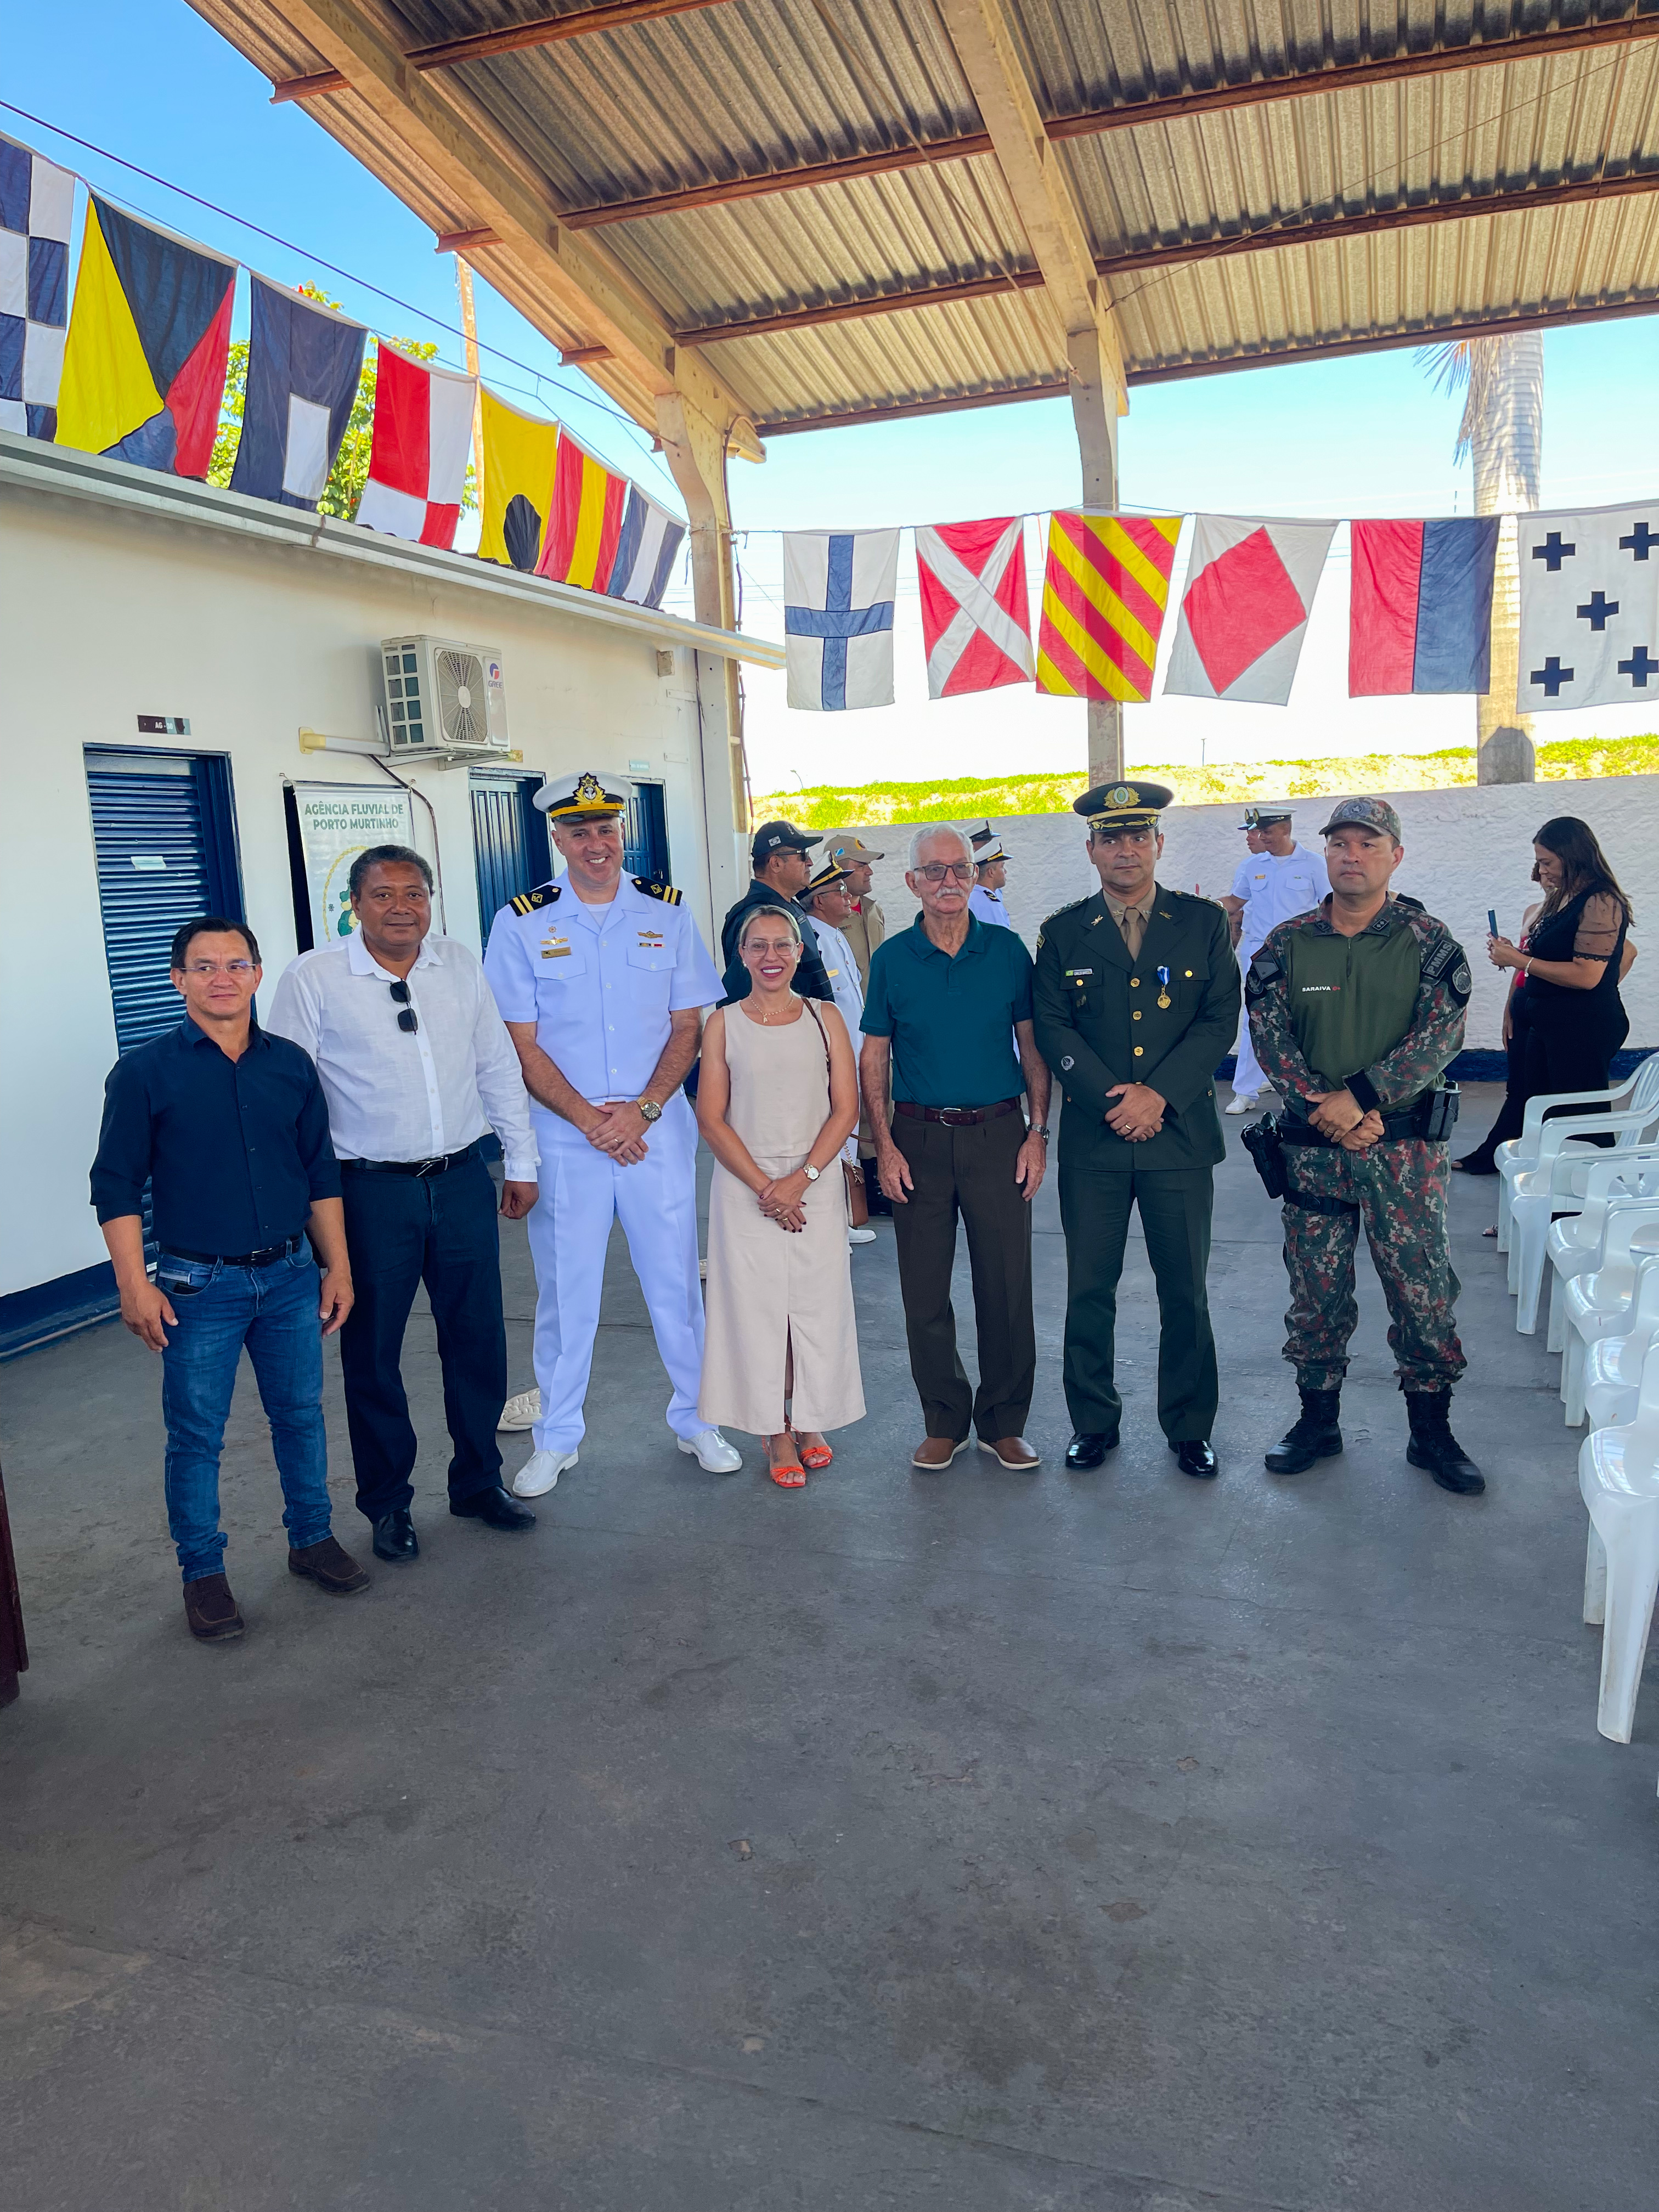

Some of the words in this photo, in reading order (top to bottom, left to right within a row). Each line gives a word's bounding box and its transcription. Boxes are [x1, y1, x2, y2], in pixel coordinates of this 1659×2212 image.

[488, 680, 503, 689] GREE
[304, 801, 349, 815] AGÊNCIA
[351, 804, 390, 815] FLUVIAL
[392, 804, 404, 815] DE
[313, 819, 347, 830] PORTO
[349, 818, 399, 830] MURTINHO
[1426, 943, 1453, 974] PMMS
